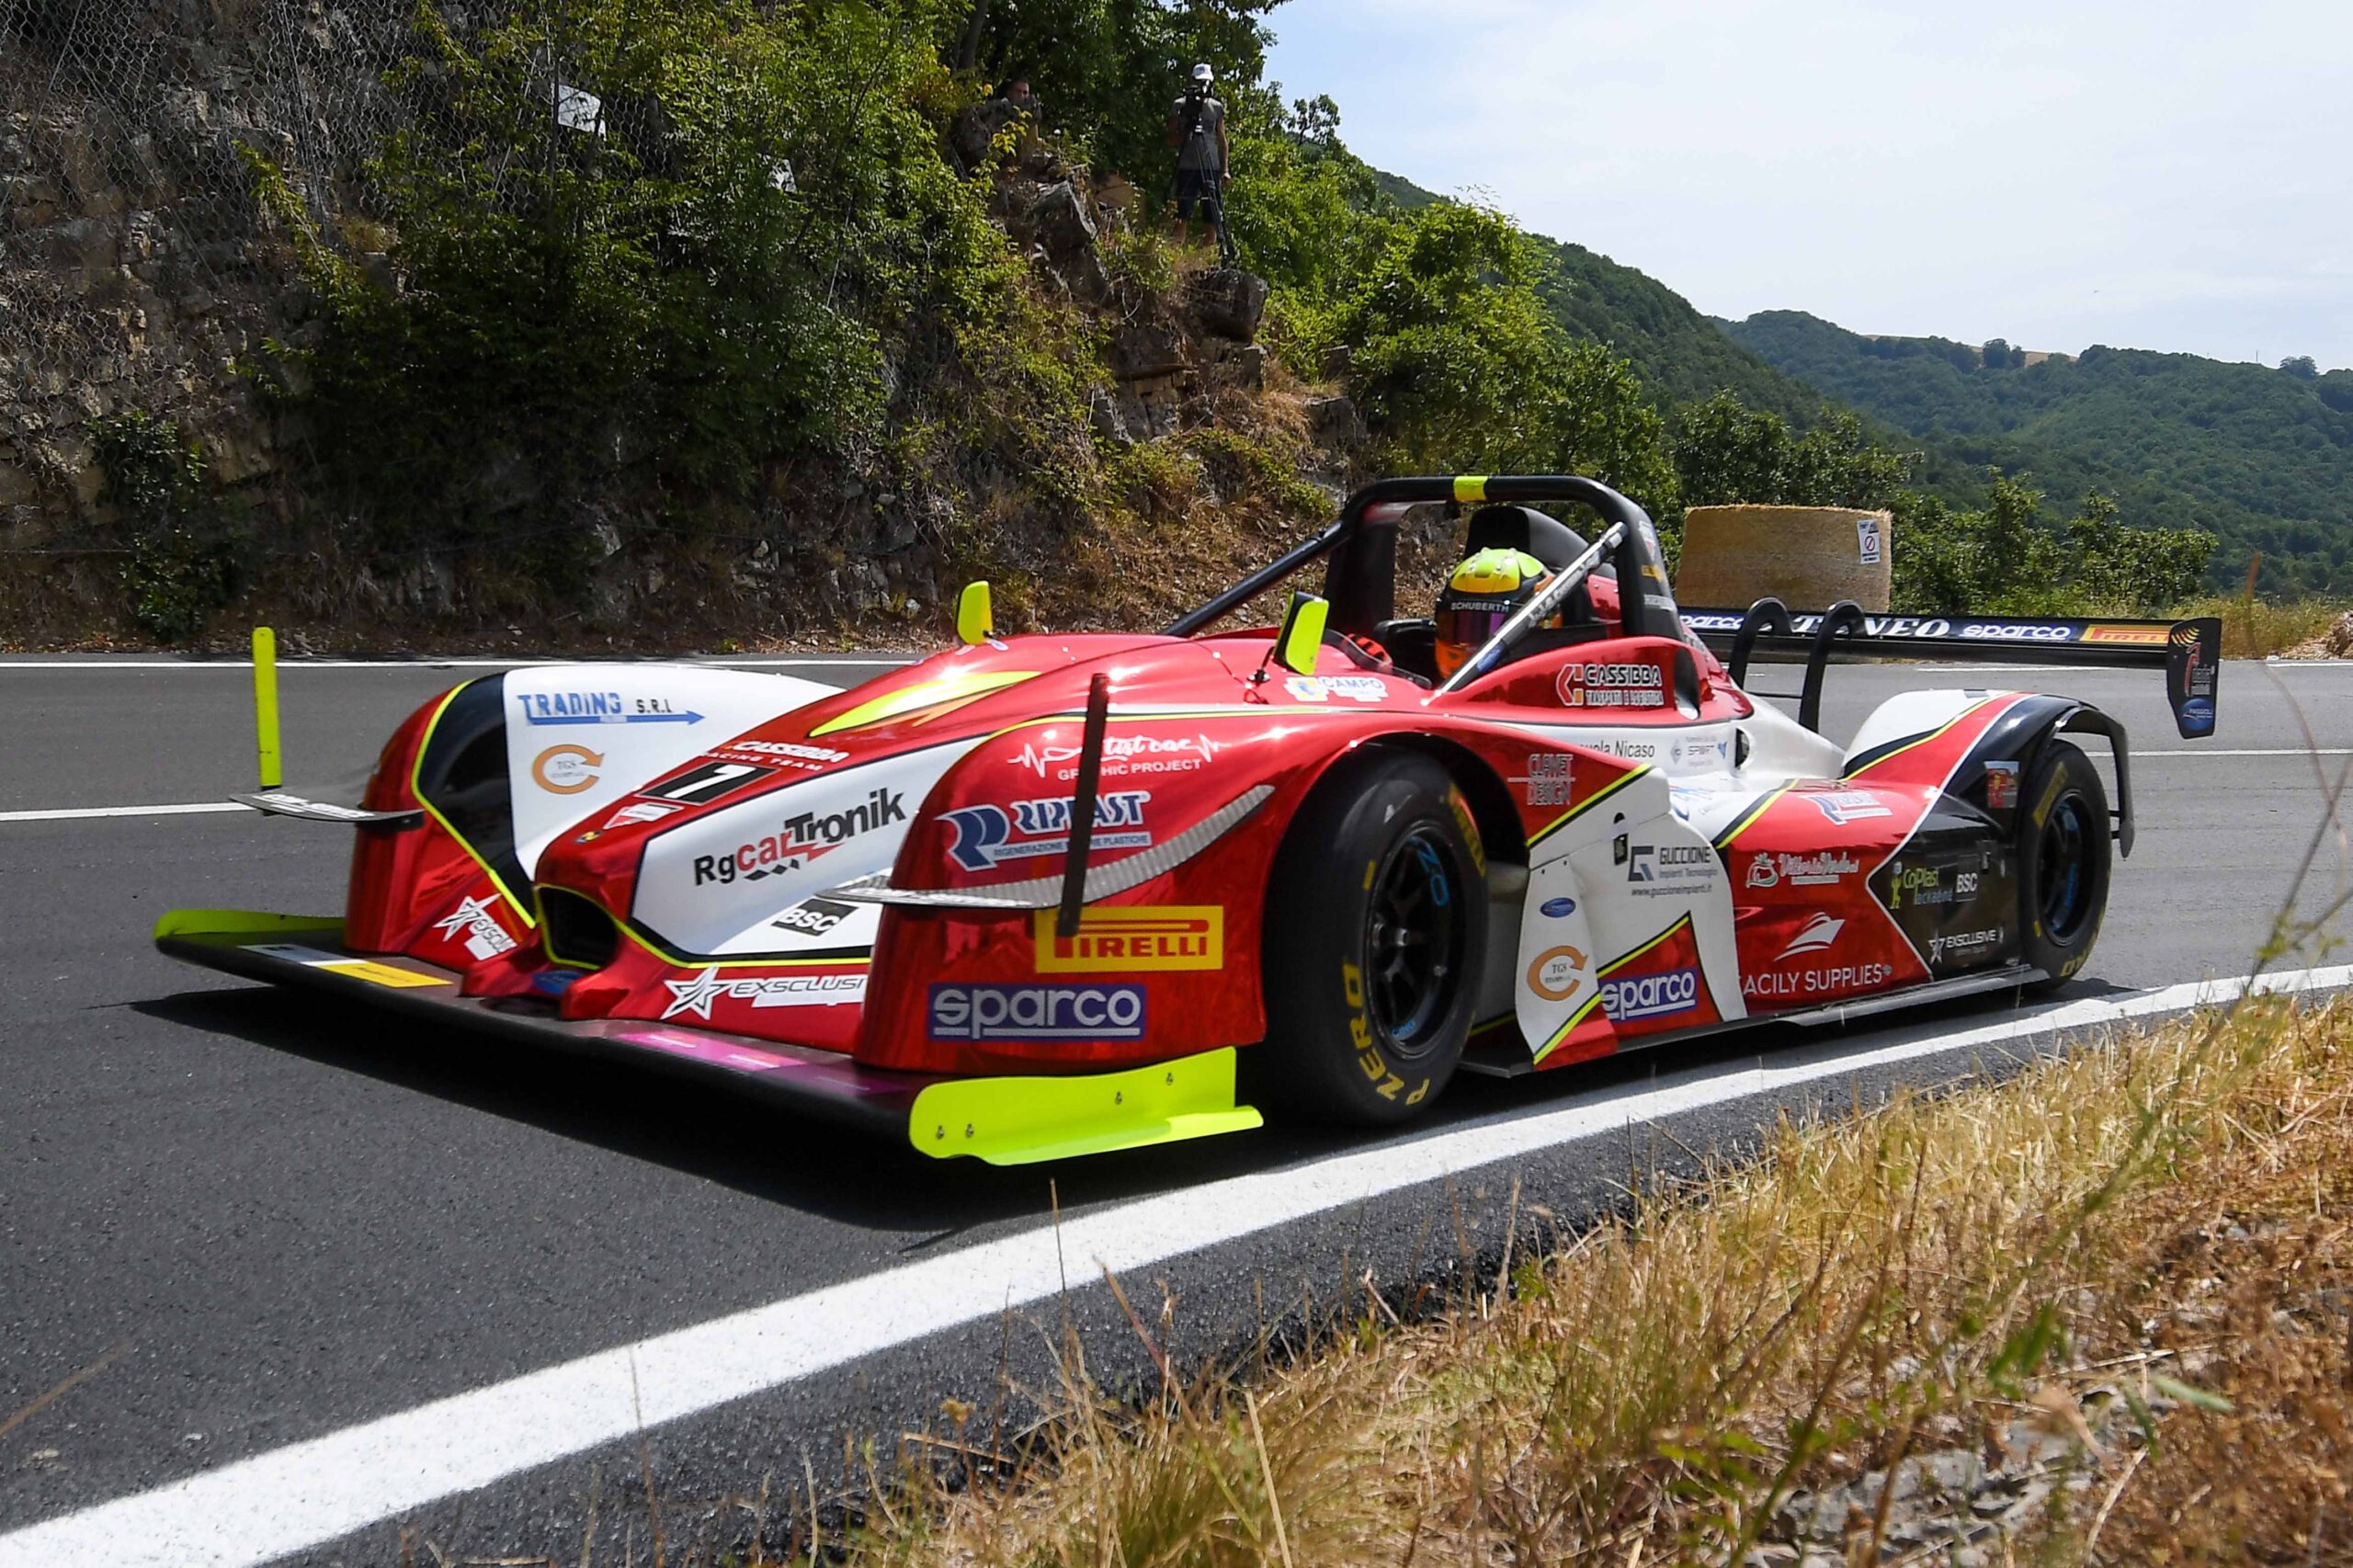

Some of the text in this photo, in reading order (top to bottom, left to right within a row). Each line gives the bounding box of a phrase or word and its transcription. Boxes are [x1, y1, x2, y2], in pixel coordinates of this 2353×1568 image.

[1450, 601, 1510, 613] SCHUBERTH
[1961, 623, 2072, 641] sparco
[1585, 665, 1662, 686] CASSIBBA
[1614, 740, 1655, 758] Nicaso
[1057, 758, 1202, 781] GRHIC PROJECT
[1956, 872, 1978, 893] BSC
[779, 908, 840, 932] BSC
[1053, 919, 1211, 960] PIRELLI
[733, 977, 866, 995] EXSCLUSI
[1737, 962, 1883, 995] ACILY SUPPLIES
[1600, 971, 1696, 1021] sparco
[932, 987, 1142, 1040] sparco
